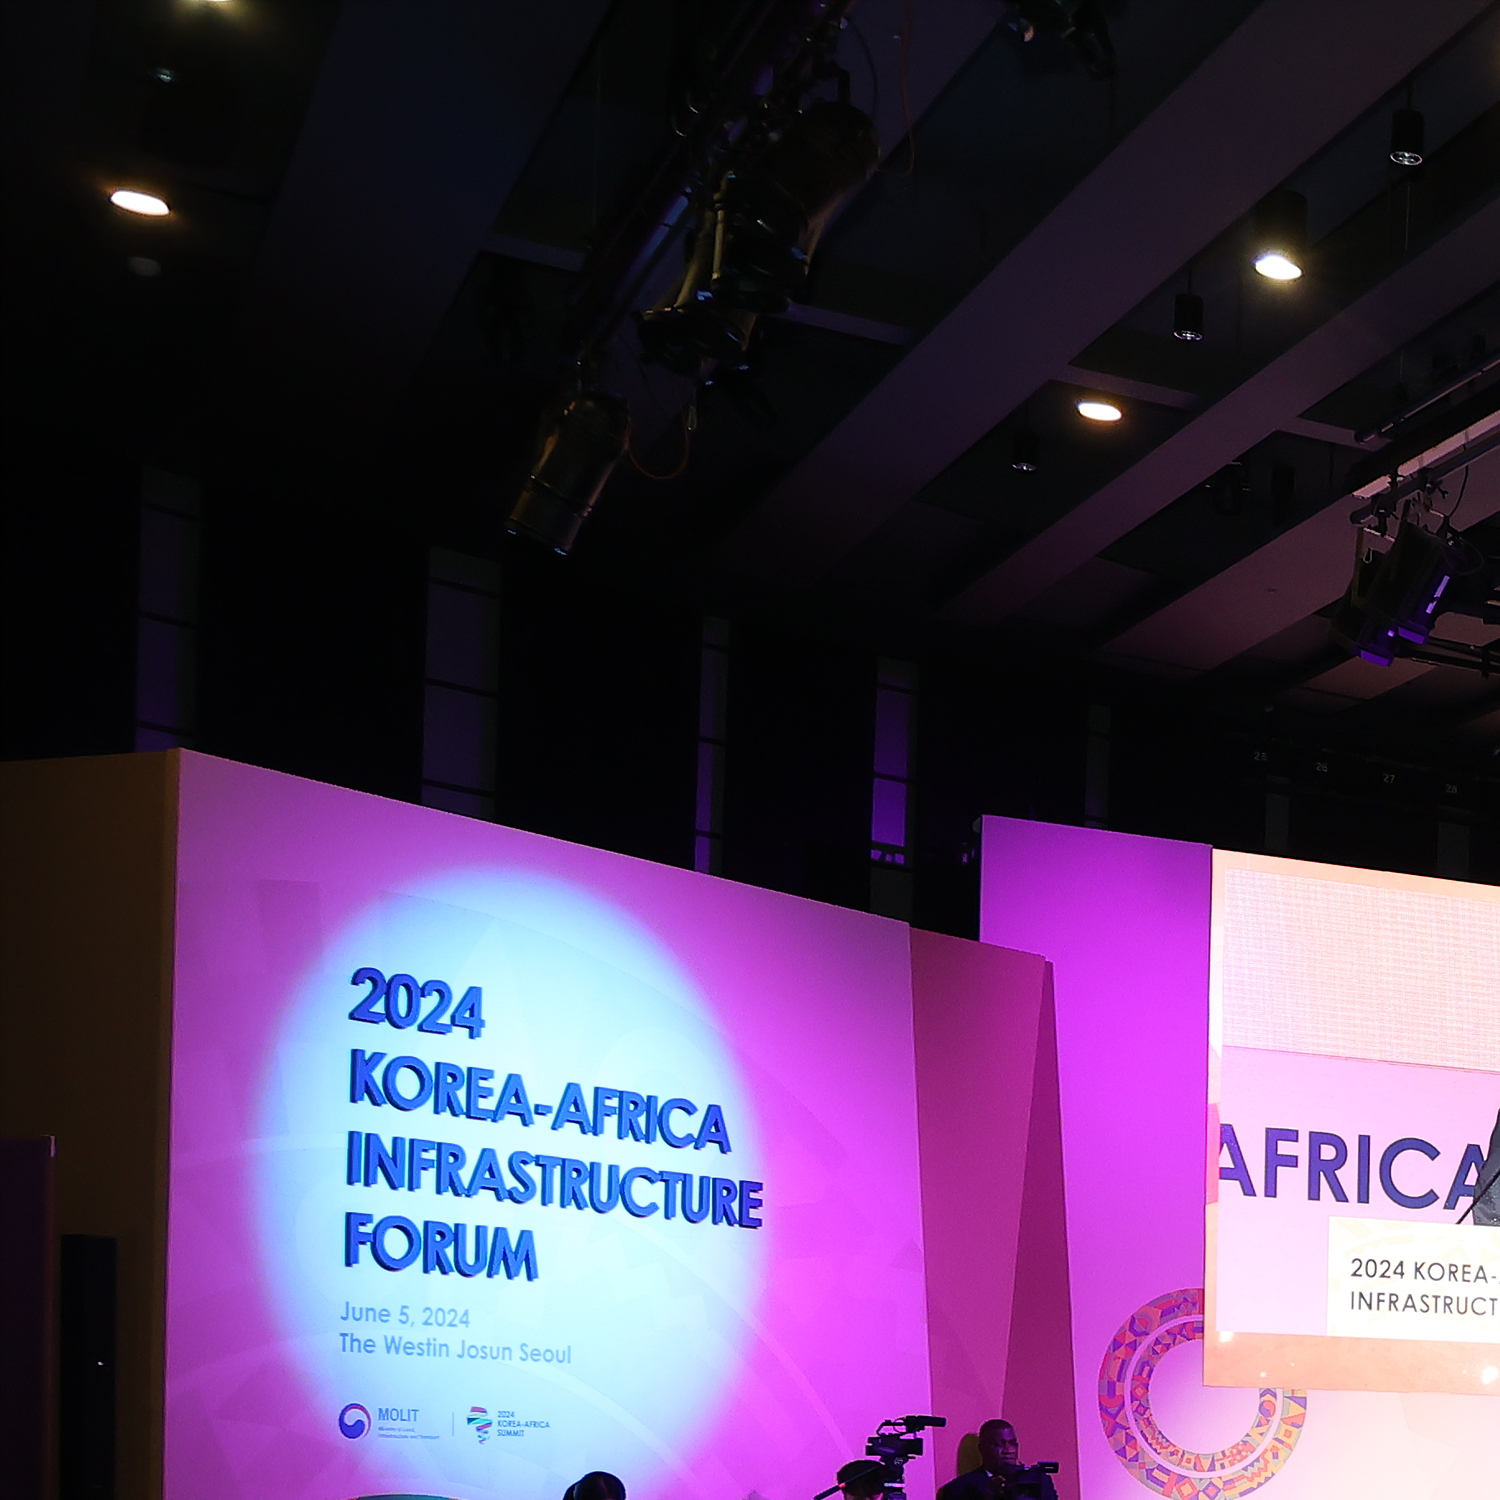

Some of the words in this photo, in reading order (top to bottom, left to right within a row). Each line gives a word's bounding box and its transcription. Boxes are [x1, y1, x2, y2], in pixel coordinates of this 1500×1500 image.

[349, 967, 486, 1039] 2024
[350, 1048, 732, 1155] KOREA-AFRICA
[347, 1132, 763, 1229] INFRASTRUCTURE
[1219, 1123, 1488, 1210] AFRICA
[344, 1213, 539, 1281] FORUM
[1350, 1258, 1405, 1279] 2024
[340, 1301, 391, 1323] June
[398, 1305, 415, 1328] 5,
[422, 1307, 470, 1328] 2024
[339, 1333, 377, 1353] The
[384, 1335, 450, 1358] Westin
[457, 1340, 513, 1361] Josun
[519, 1343, 572, 1364] Seoul
[378, 1407, 420, 1422] MOLIT
[497, 1419, 551, 1429] KOREA-AFRICA
[497, 1429, 525, 1437] SUMMIT
